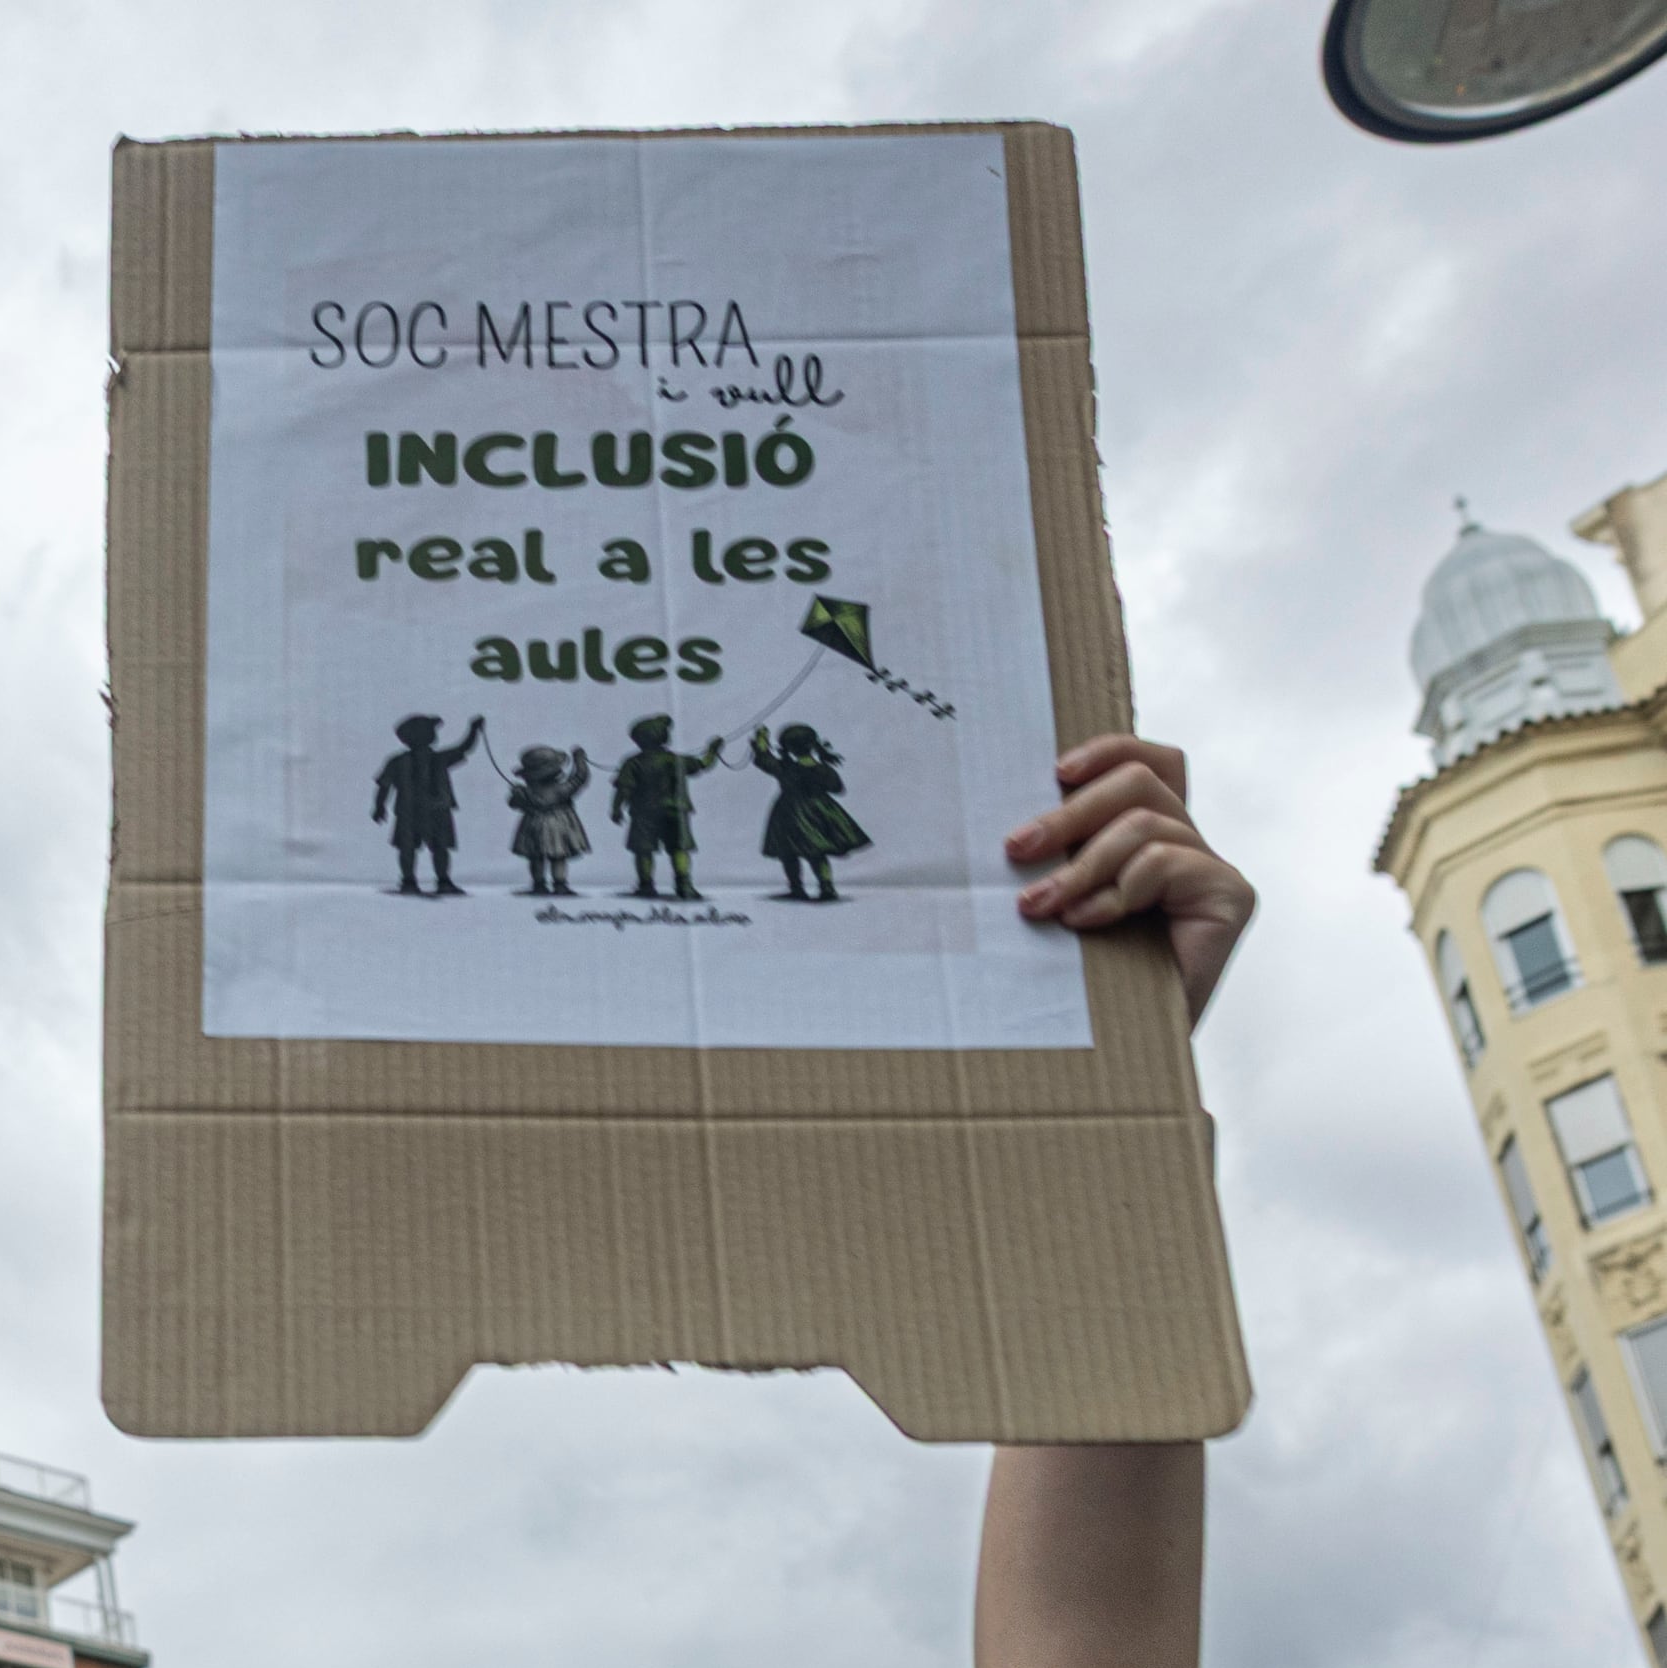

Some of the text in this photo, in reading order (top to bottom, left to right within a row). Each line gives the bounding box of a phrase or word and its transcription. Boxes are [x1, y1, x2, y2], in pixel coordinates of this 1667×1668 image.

[309, 300, 760, 370] SOC MESTRA
[657, 353, 845, 407] i vull
[365, 415, 814, 488] INCLUSIÓ
[354, 529, 832, 584] real a les
[470, 627, 724, 684] aules
